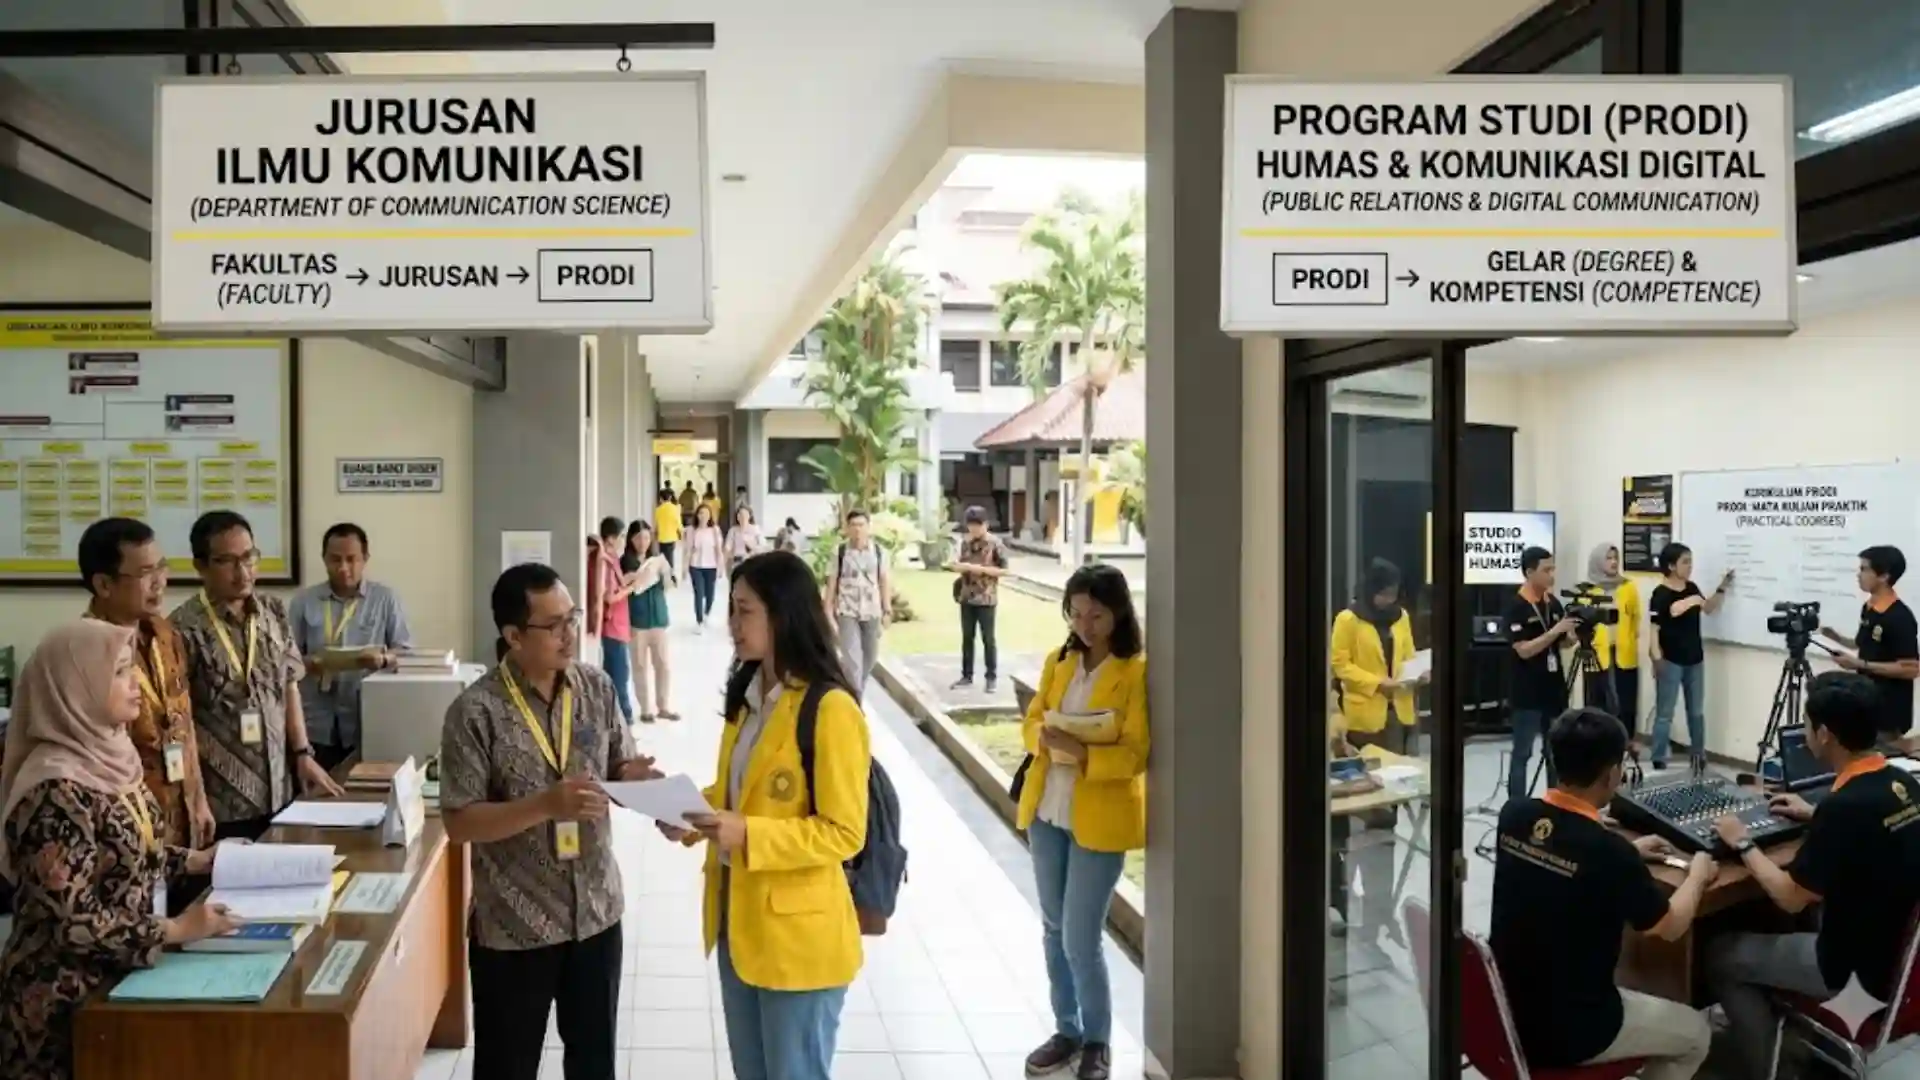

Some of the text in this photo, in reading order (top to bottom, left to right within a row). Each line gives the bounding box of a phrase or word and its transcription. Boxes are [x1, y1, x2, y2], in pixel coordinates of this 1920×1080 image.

[316, 98, 536, 135] JURUSAN
[1273, 103, 1748, 143] PROGRAM STUDI (PRODI)
[217, 145, 643, 184] ILMU KOMUNIKASI
[1257, 150, 1766, 179] HUMAS & KOMUNIKASI DIGITAL
[190, 193, 671, 221] (DEPARTMENT OF COMMUNICATION SCIENCE)
[1262, 191, 1760, 215] (PUBLIC RELATIONS & DIGITAL COMMUNICATION)
[211, 253, 338, 275] FAKULTAS
[556, 265, 635, 286] PRODI
[1488, 250, 1698, 276] GELAR (DEGREE) &
[378, 265, 498, 288] JURUSAN
[1292, 269, 1369, 290] PRODI
[217, 282, 332, 309] (FACULTY)
[1429, 280, 1761, 307] KOMPETENSI (COMPETENCE)
[1469, 527, 1521, 538] STUDIO
[1469, 557, 1522, 569] HUMAS
